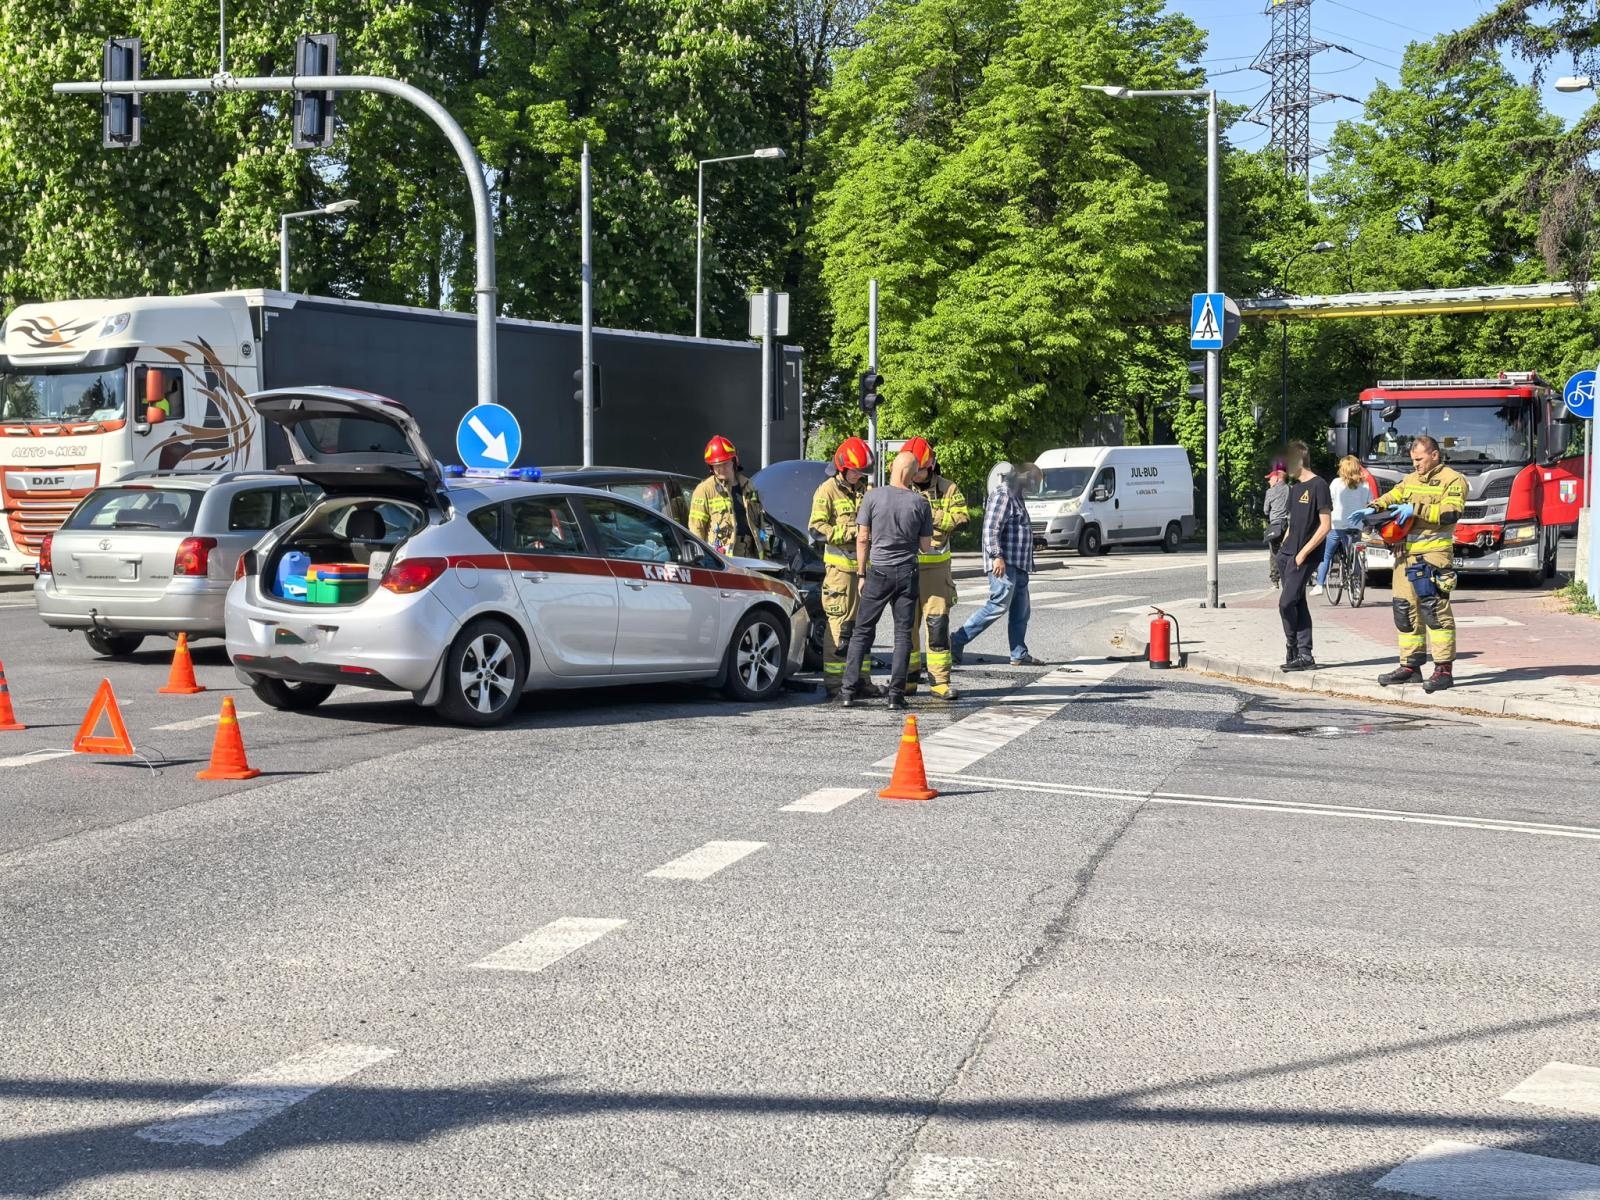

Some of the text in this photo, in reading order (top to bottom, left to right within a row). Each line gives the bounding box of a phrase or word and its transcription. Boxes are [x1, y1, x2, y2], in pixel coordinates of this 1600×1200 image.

[1131, 466, 1158, 478] JUL-BUD
[32, 476, 65, 485] DAF
[642, 564, 692, 583] KREW
